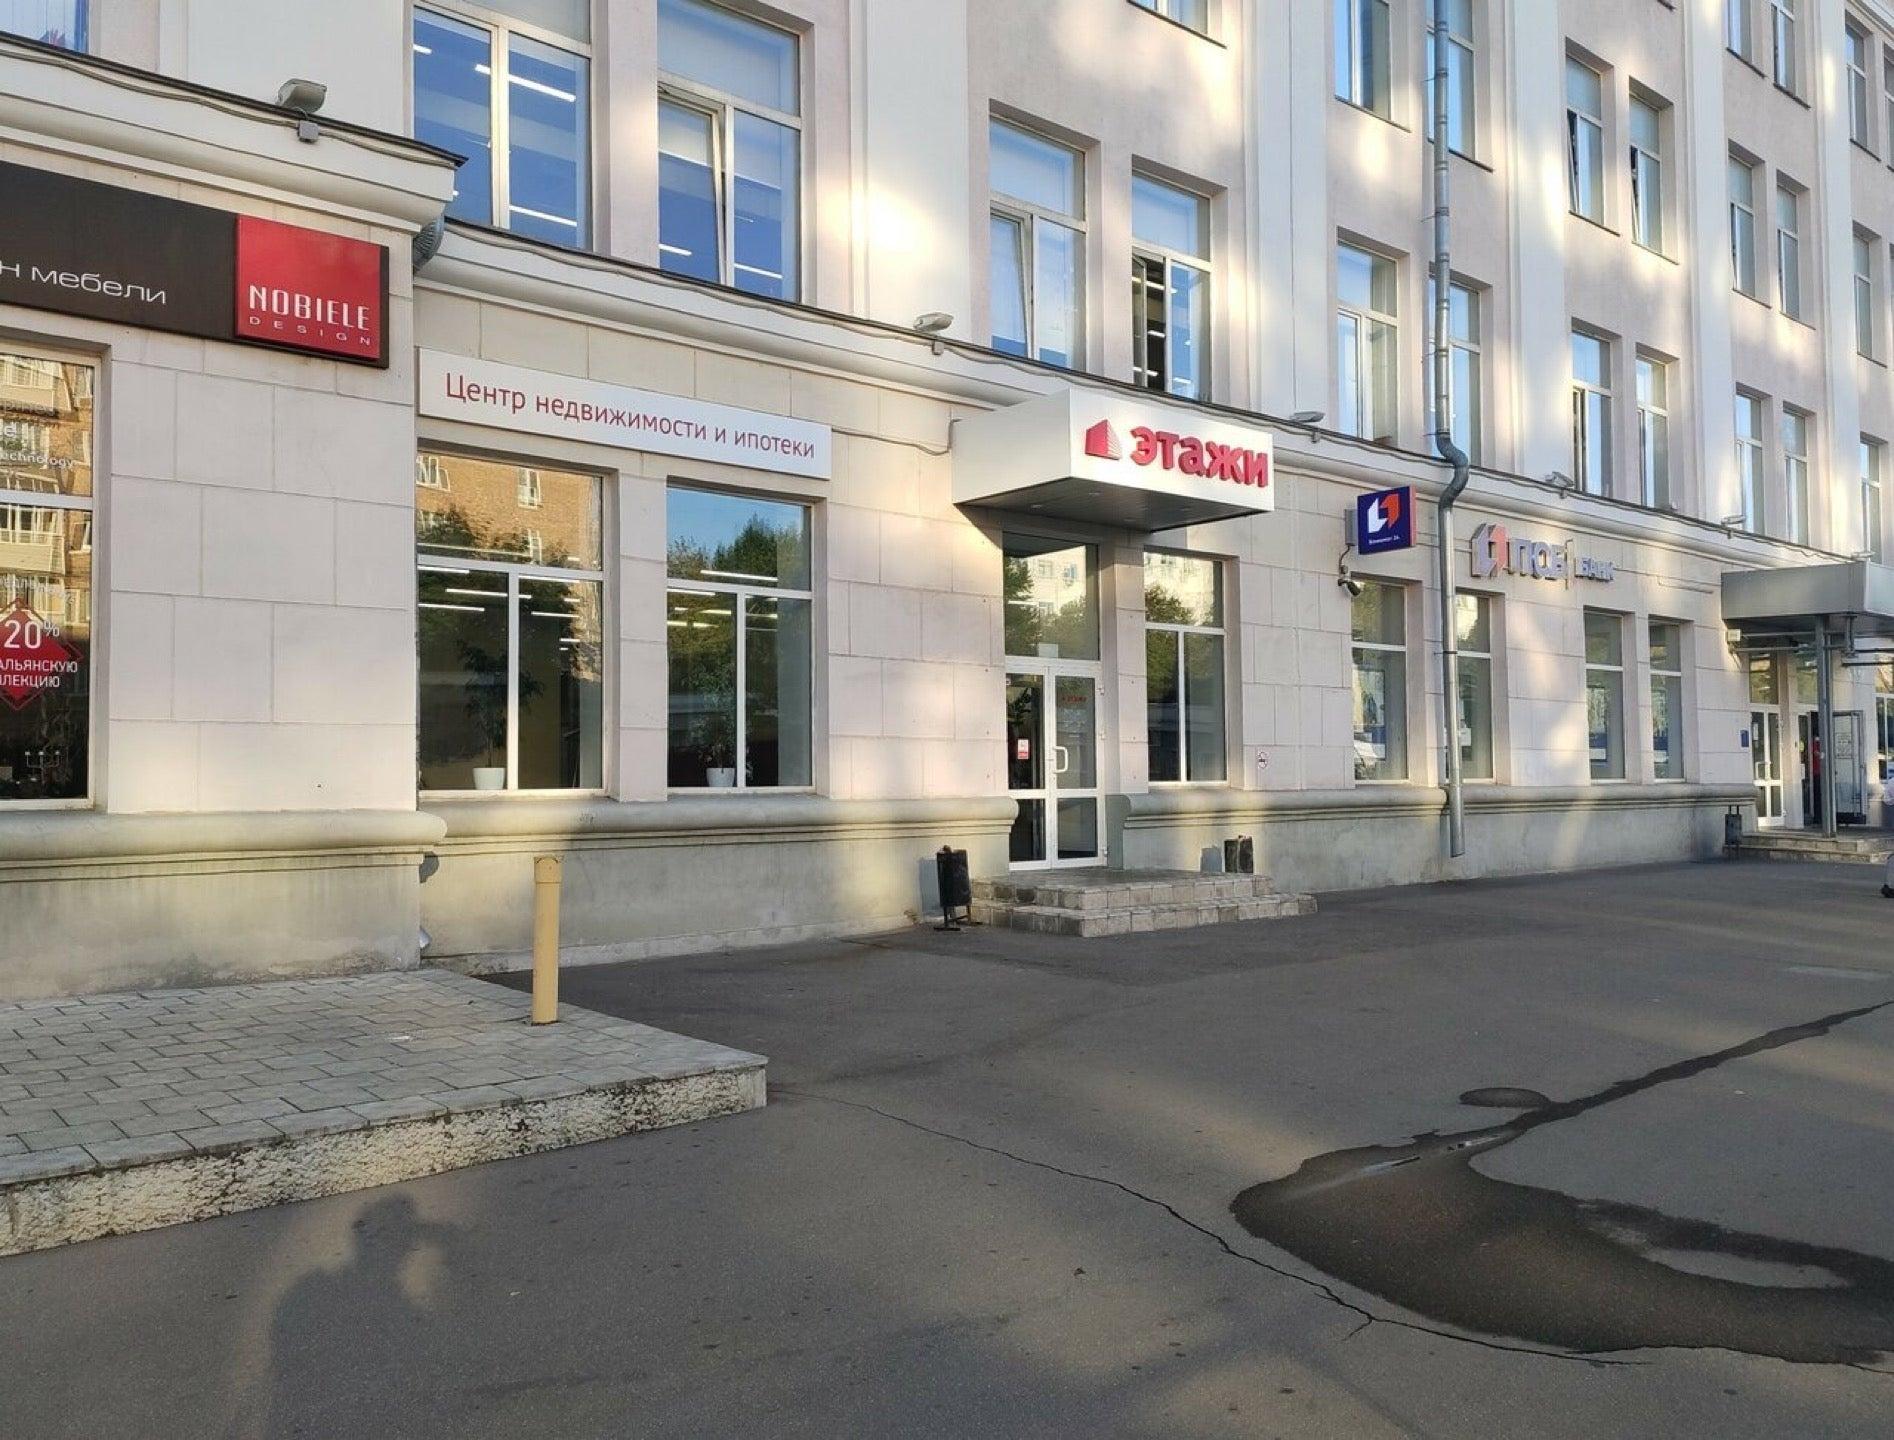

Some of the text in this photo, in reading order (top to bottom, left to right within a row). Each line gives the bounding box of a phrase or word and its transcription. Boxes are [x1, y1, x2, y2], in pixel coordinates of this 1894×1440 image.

[32, 265, 166, 304] мебели
[249, 284, 370, 331] NOBIELE
[249, 316, 371, 346] DESIGN
[446, 371, 815, 460] Центр недвижимости и ипотеки
[0, 674, 60, 688] ЛЕКЦИЮ
